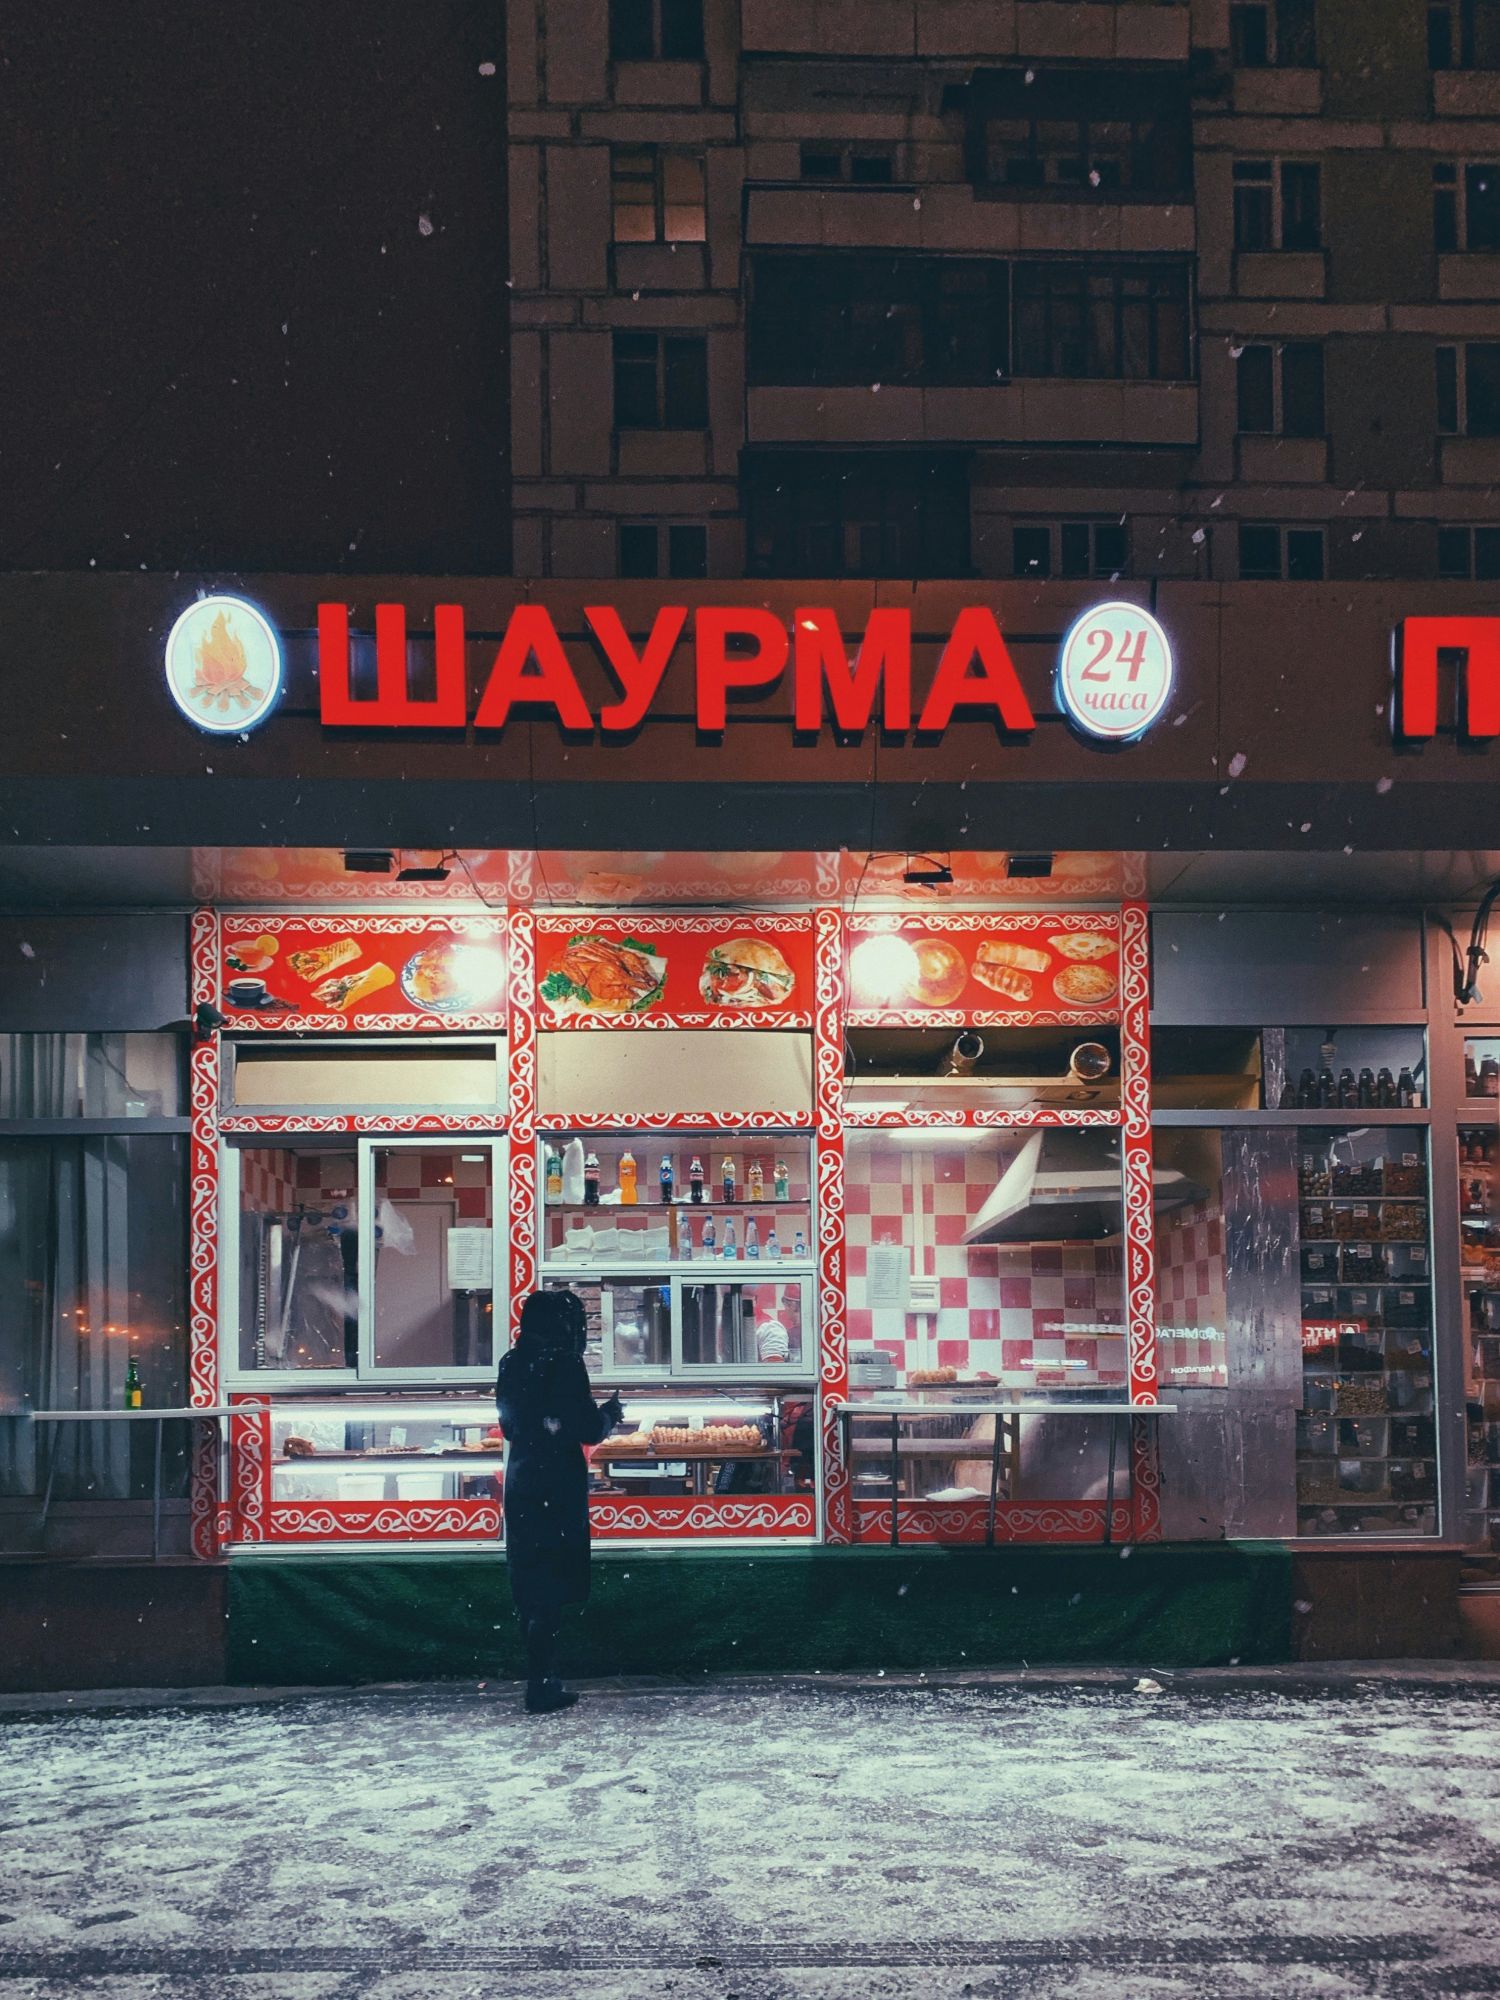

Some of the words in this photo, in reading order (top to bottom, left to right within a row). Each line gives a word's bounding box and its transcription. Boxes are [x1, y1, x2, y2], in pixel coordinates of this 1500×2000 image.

[317, 603, 1035, 731] ШАУРМА
[1081, 629, 1147, 682] 24
[1085, 692, 1148, 710] часа
